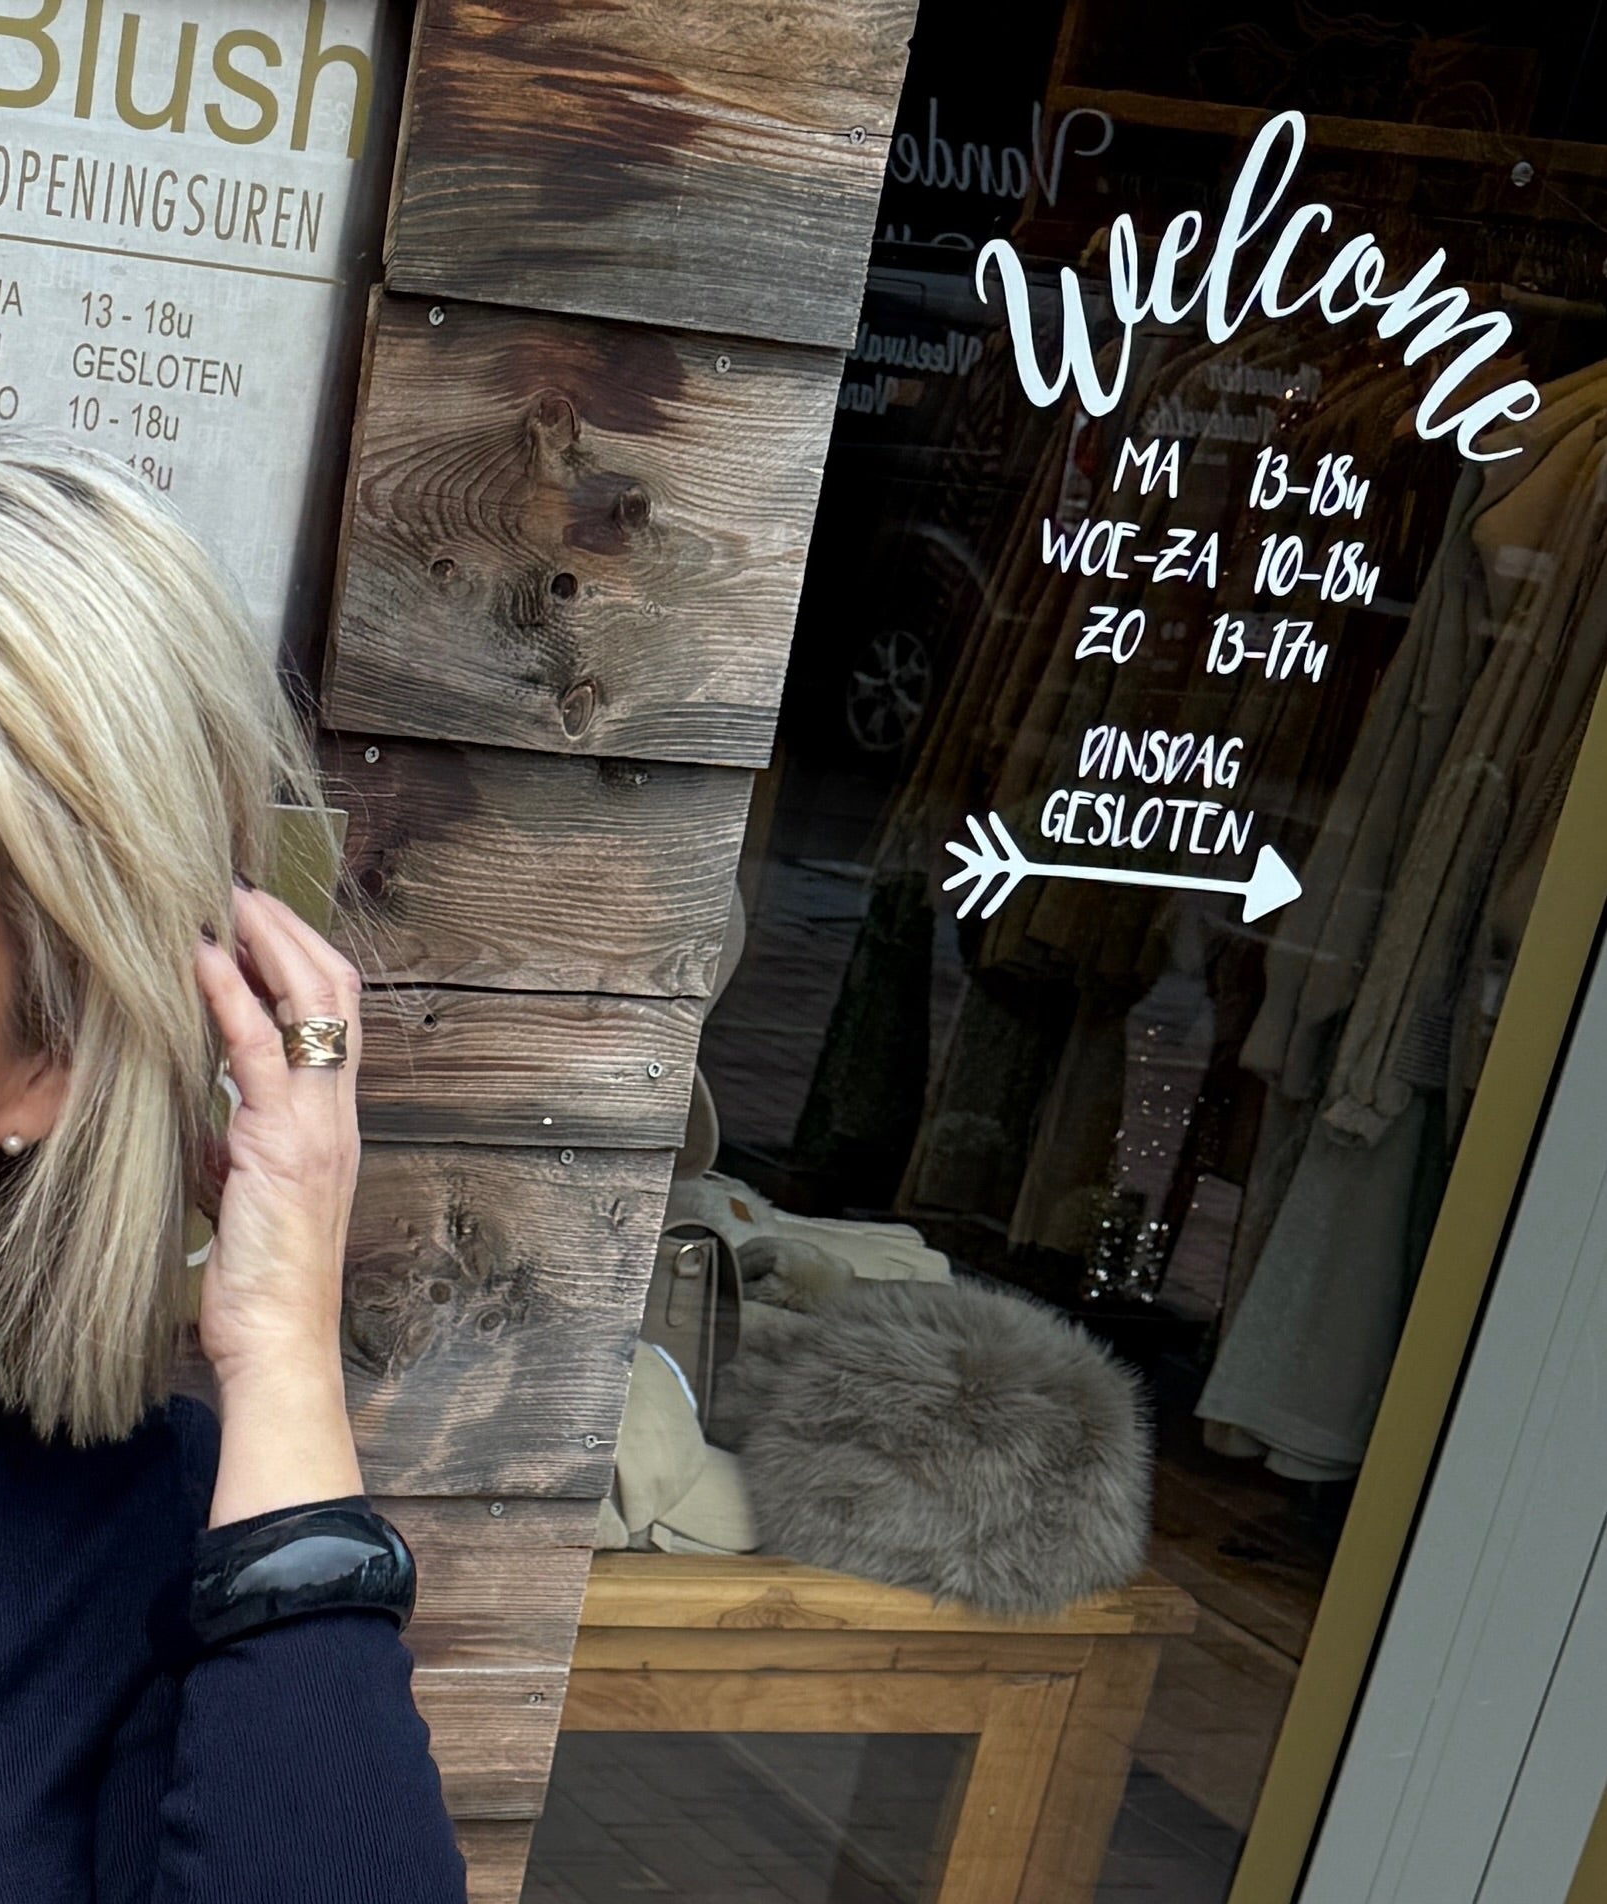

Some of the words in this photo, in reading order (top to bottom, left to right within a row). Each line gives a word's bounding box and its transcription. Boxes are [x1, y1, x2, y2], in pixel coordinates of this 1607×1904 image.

[81, 291, 113, 329] 13
[144, 299, 194, 340] 18u
[975, 110, 1541, 462] Welcome
[72, 342, 243, 398] GESLOTEN
[68, 395, 100, 432] 10
[131, 403, 180, 442] 18u
[1112, 437, 1180, 499] MA
[1249, 446, 1371, 520] 13-18u
[1042, 518, 1219, 589] WOE-ZA
[1254, 533, 1381, 606] 10-18u
[1074, 605, 1146, 664] ZO
[1206, 613, 1329, 683] 13-17u
[1078, 725, 1244, 789] DINSDAG
[1040, 789, 1255, 856] GESLOTEN
